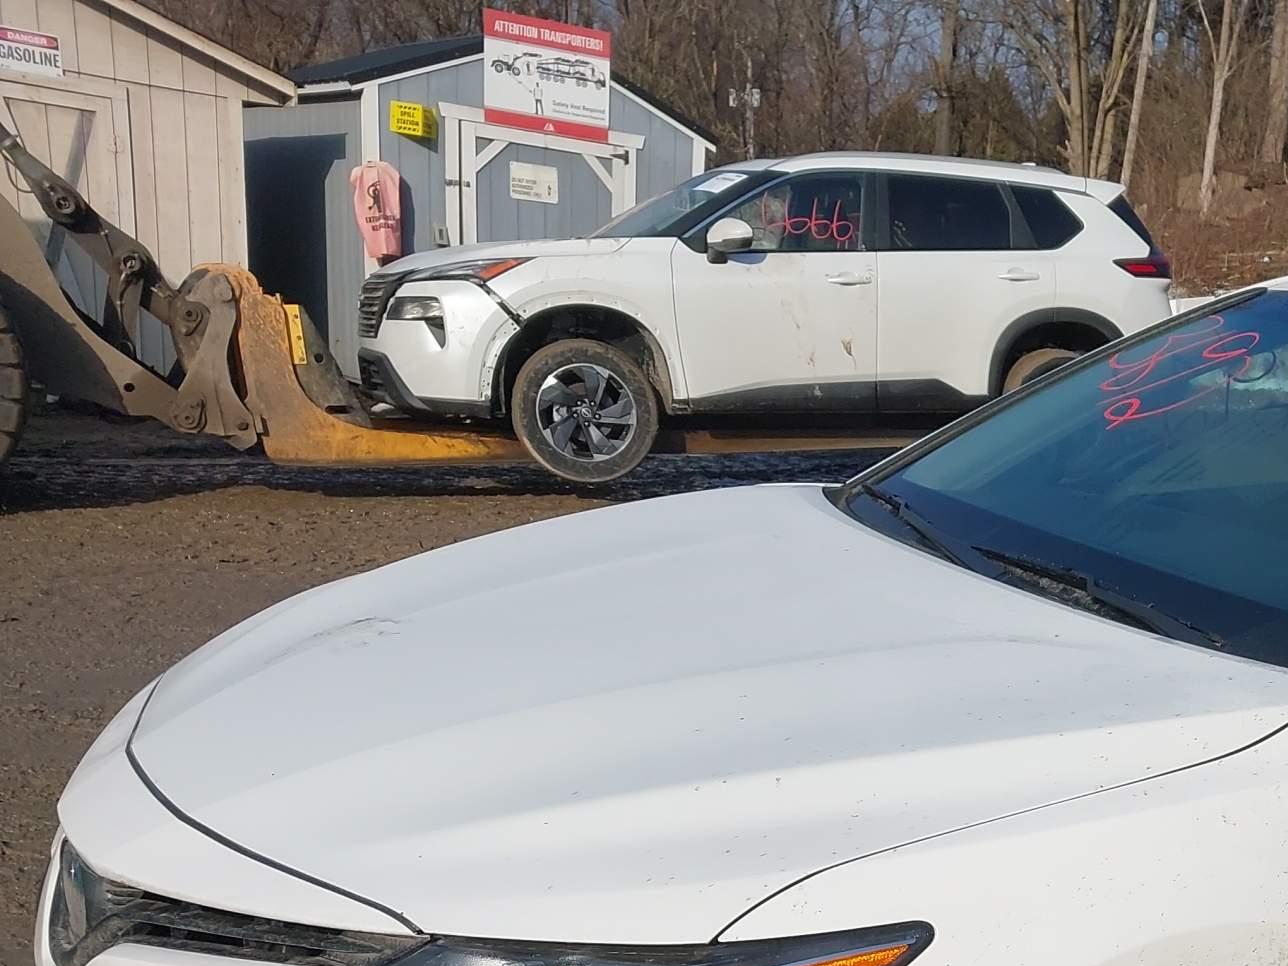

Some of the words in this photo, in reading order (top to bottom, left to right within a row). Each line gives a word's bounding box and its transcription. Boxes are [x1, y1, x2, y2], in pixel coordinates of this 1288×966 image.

[494, 20, 538, 39] ATTENTION
[540, 28, 603, 51] TRANSPORTERS!
[0, 43, 61, 69] GASOLINE
